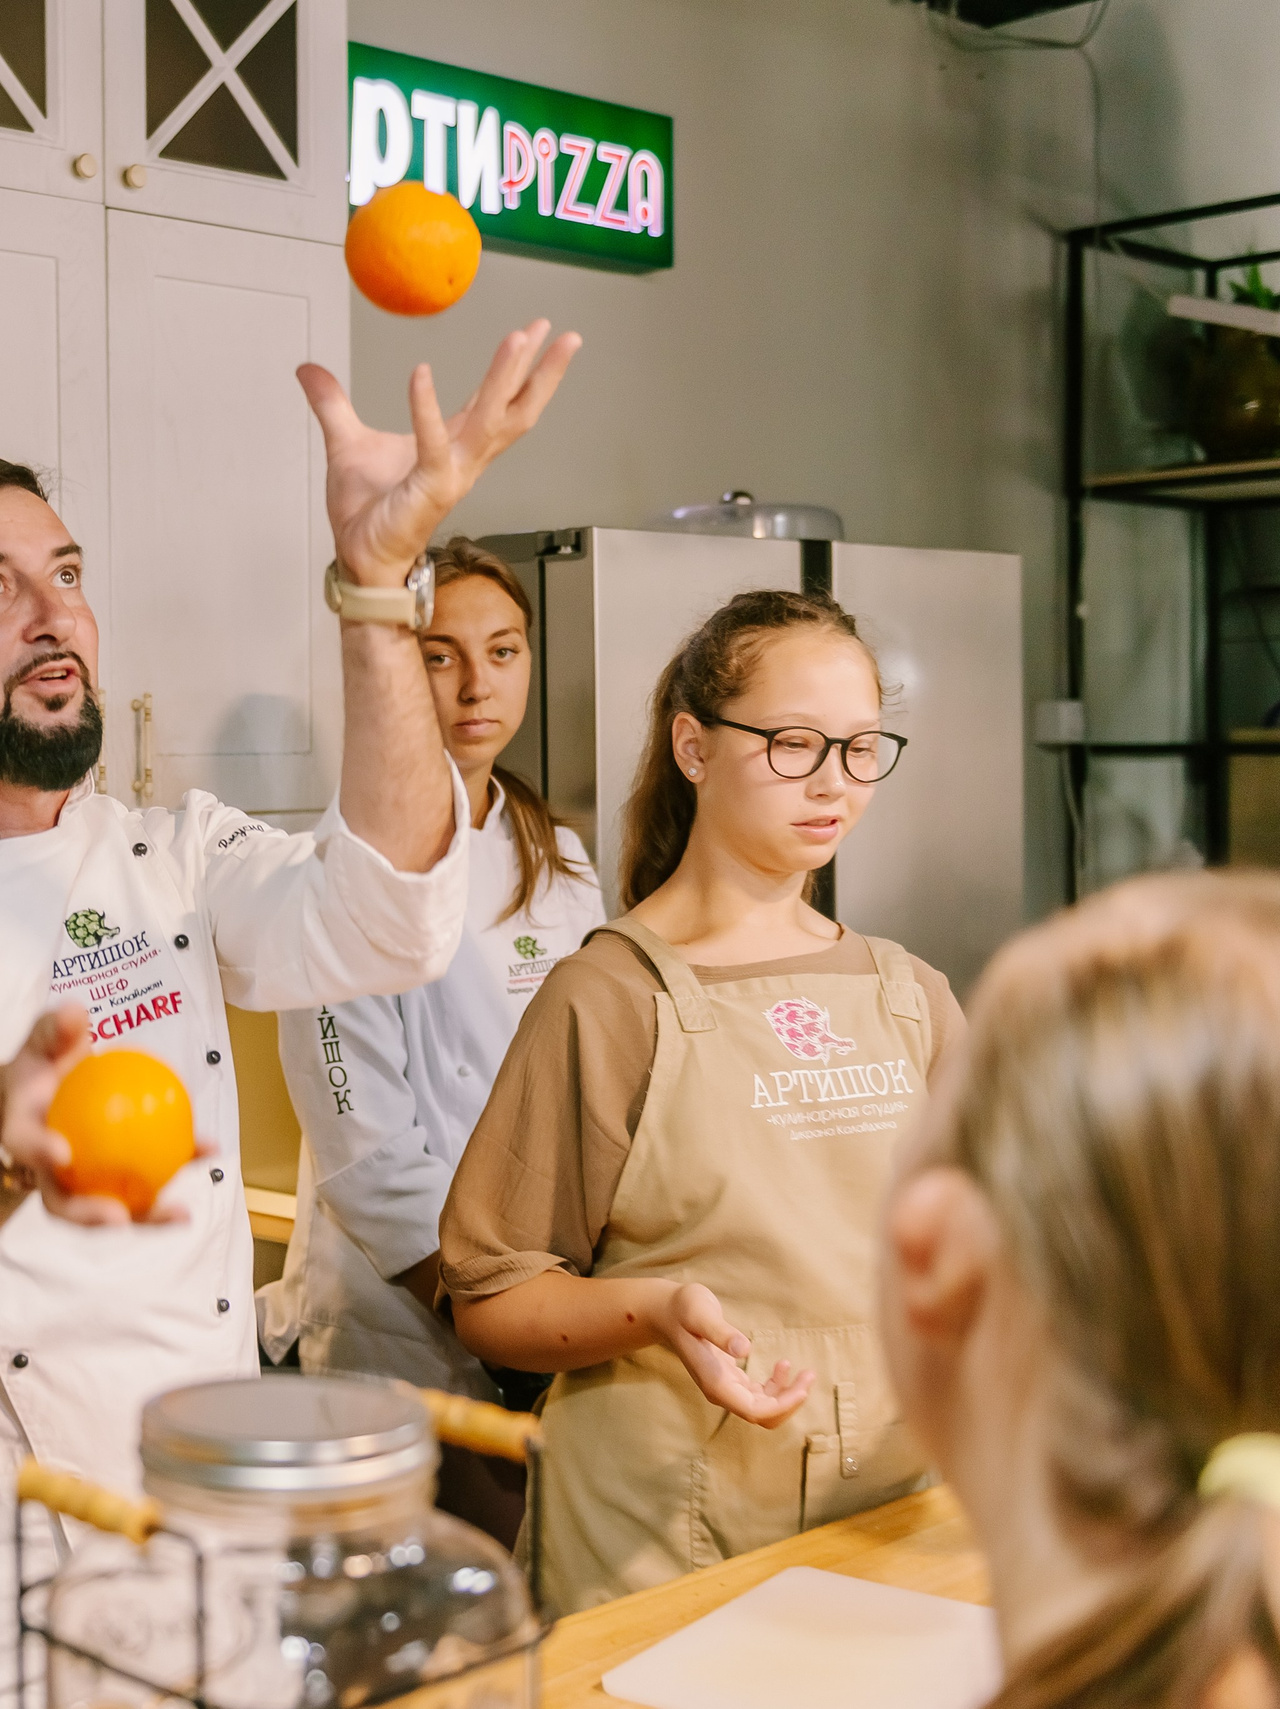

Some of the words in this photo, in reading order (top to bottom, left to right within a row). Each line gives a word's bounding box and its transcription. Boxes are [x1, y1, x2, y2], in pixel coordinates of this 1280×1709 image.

[52, 931, 150, 979] АРТИШОК
[508, 958, 558, 977] АРТИШ
[89, 978, 129, 1001] ШЕФ
[751, 1059, 913, 1108] АРТИШОК
